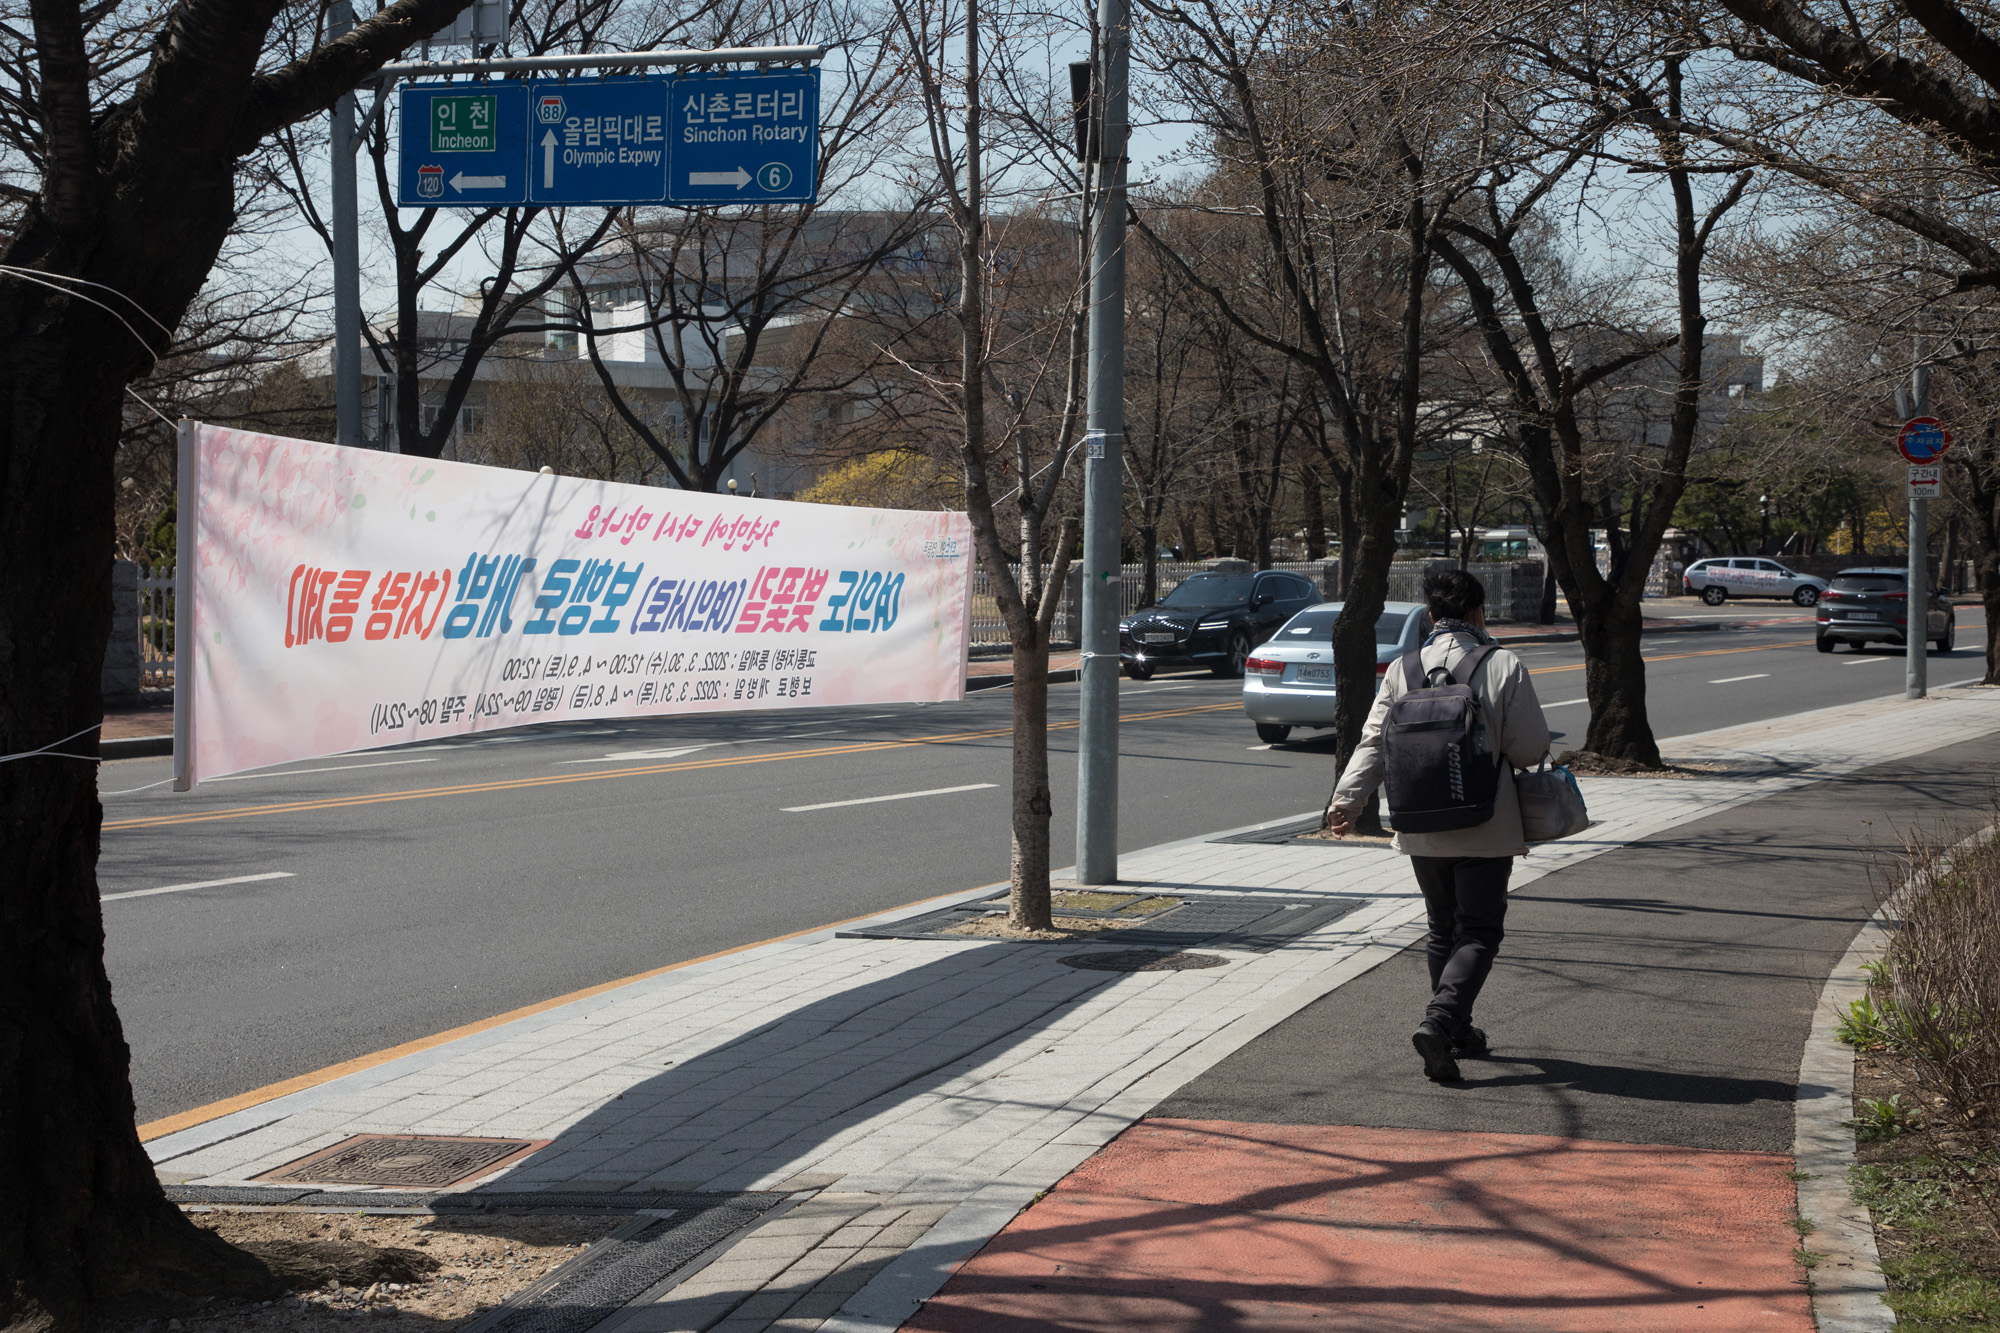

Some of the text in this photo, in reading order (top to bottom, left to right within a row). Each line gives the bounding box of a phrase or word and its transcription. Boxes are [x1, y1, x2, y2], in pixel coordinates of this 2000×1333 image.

[543, 104, 560, 120] 88
[682, 88, 804, 124] 신촌로터리
[563, 115, 664, 146] 올림픽대로
[683, 124, 809, 144] Sinchon Rotary
[438, 133, 489, 149] Incheon
[563, 148, 662, 168] Olympic Expwy
[423, 176, 439, 194] 120
[768, 167, 781, 188] 6
[1088, 445, 1103, 456] 3-1
[1911, 468, 1938, 478] 구간내
[1913, 487, 1935, 496] 100m
[1448, 742, 1465, 801] POSITIVE
